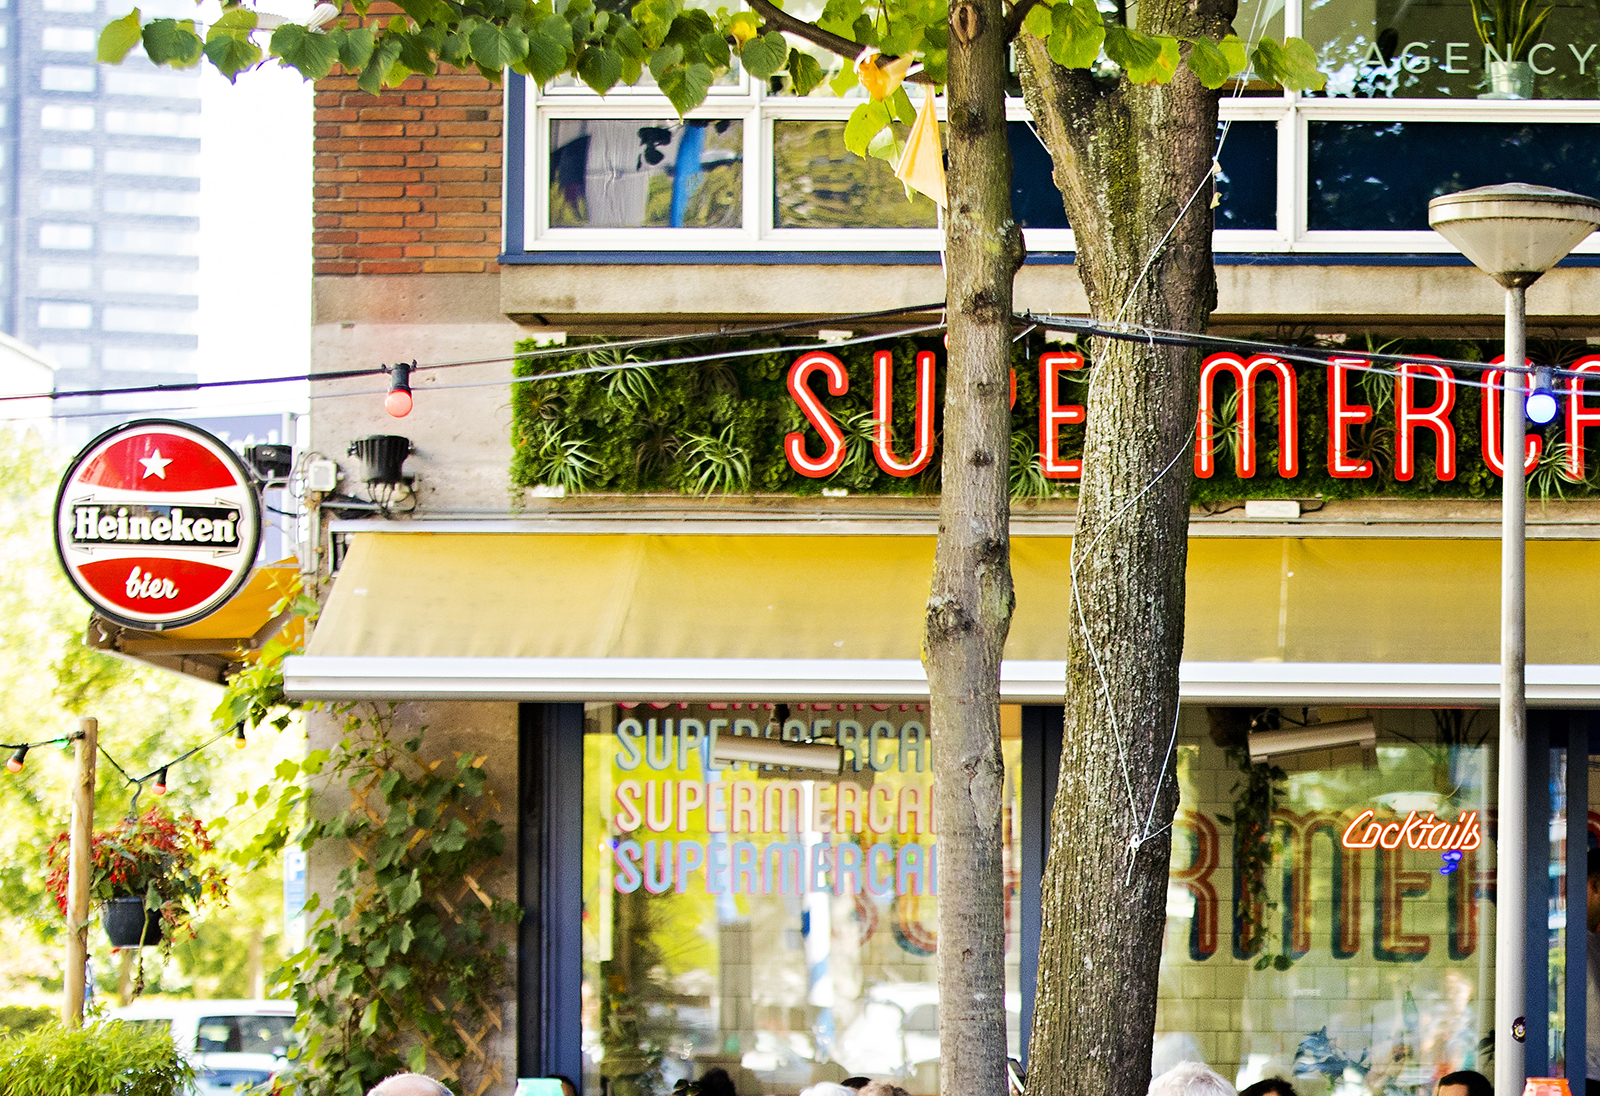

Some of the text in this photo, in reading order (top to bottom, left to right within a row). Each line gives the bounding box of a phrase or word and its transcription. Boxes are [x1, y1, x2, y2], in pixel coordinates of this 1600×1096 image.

[1361, 41, 1598, 75] AGENCY
[74, 507, 237, 543] Heineken
[125, 565, 180, 600] bier
[614, 779, 936, 834] SUPERMERCA
[1342, 808, 1482, 851] Cocktails
[613, 839, 938, 897] SUPERMERCA
